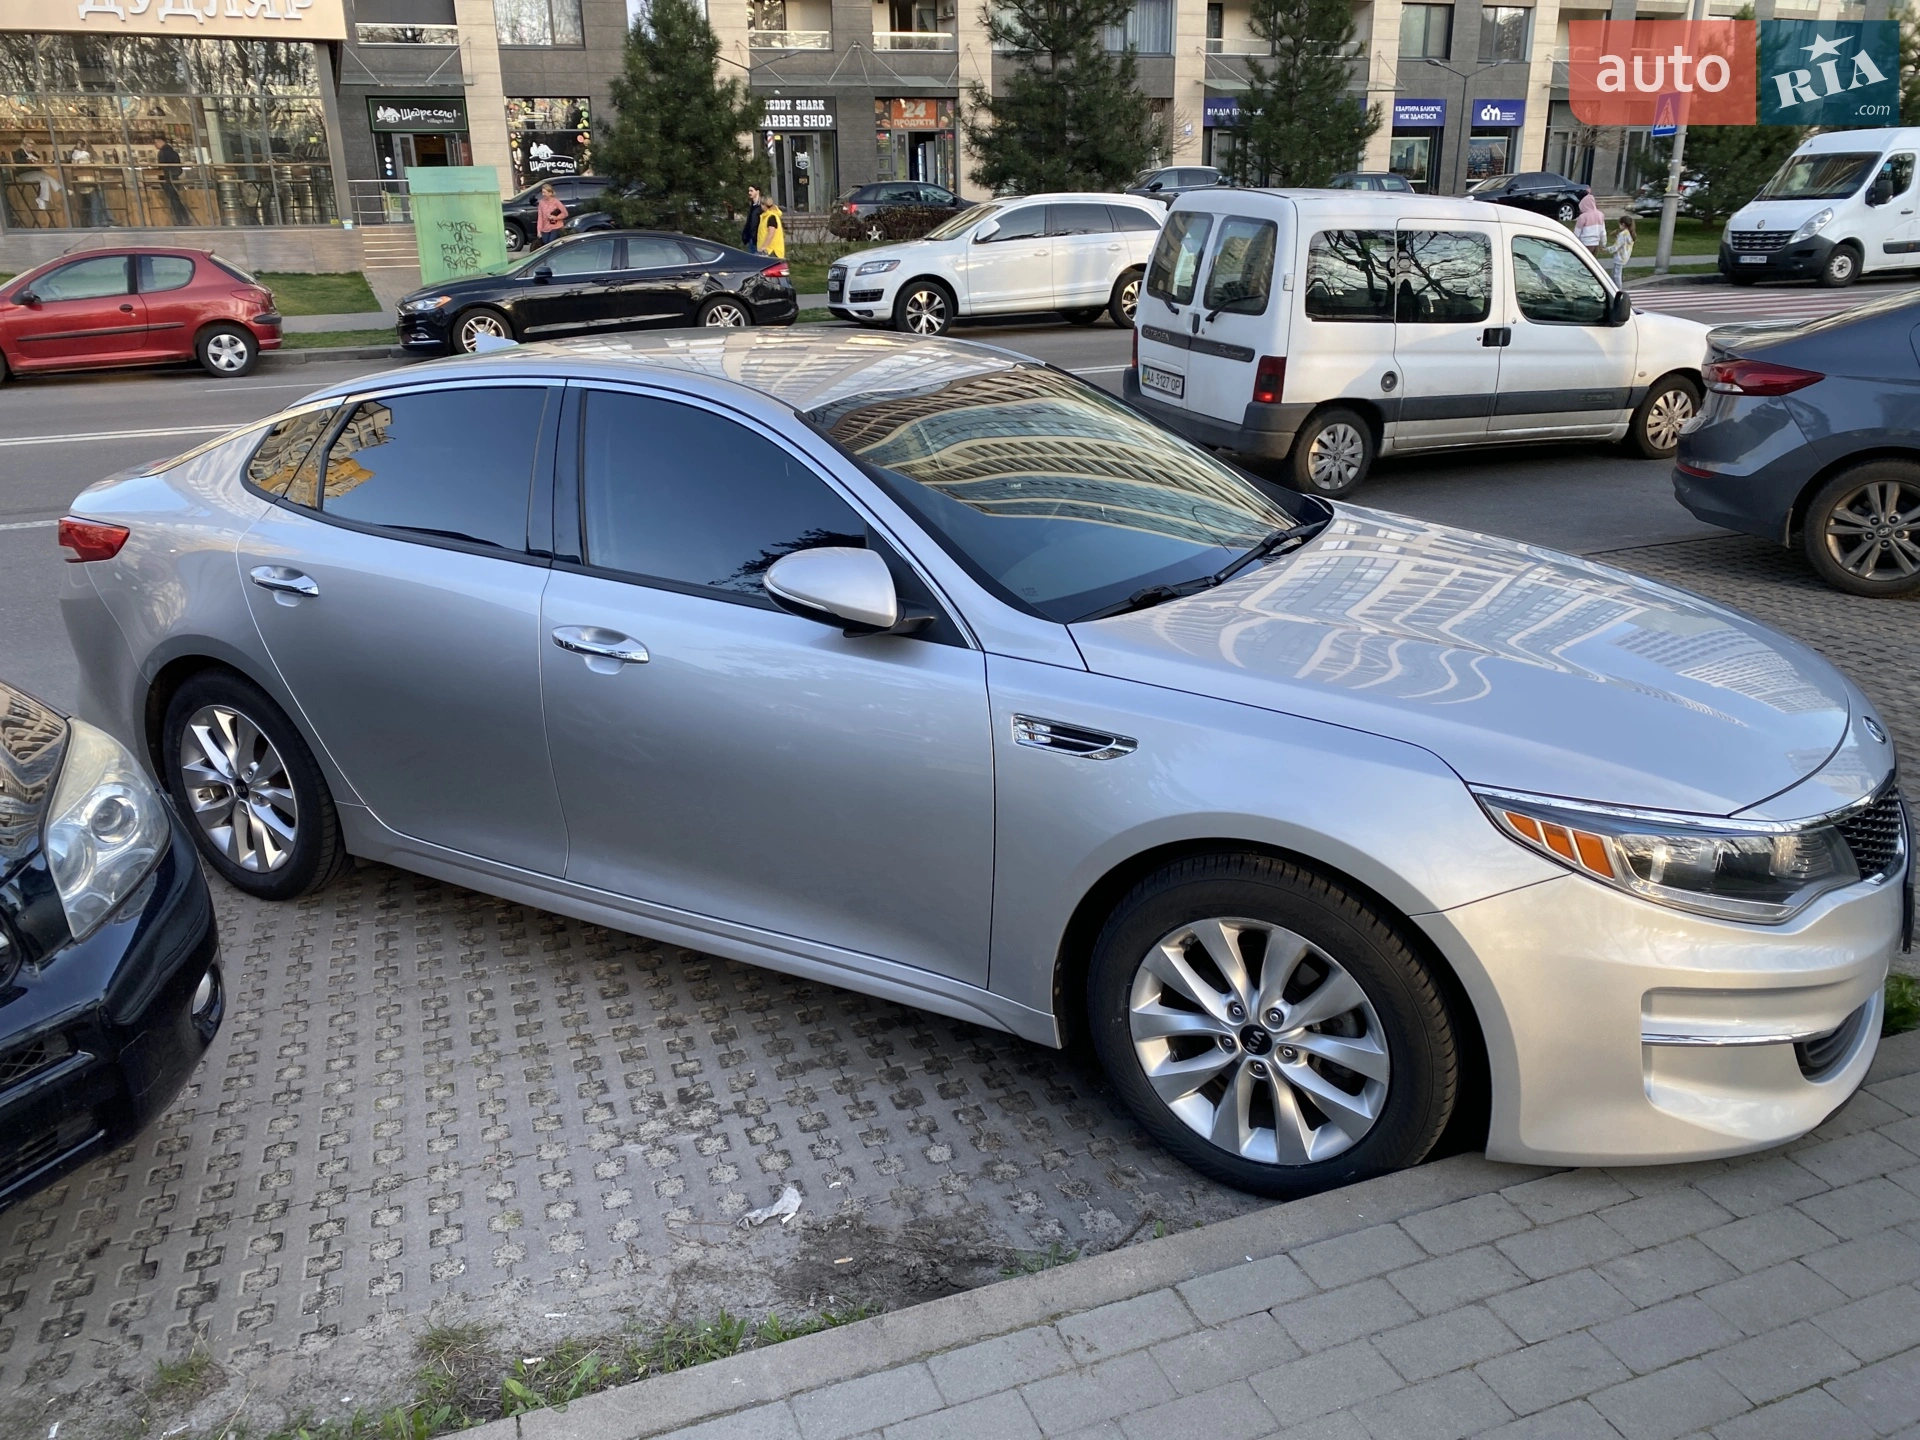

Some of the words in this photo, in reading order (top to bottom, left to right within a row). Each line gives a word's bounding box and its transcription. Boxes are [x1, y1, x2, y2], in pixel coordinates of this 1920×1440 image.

[795, 99, 825, 111] SHARK
[902, 101, 927, 118] 24
[400, 107, 432, 121] Щедре
[803, 114, 833, 127] SHOP
[893, 118, 935, 127] ПРОДУКТИ
[529, 160, 556, 172] Щедре
[1146, 370, 1154, 383] AA
[1156, 373, 1170, 389] 5127
[1246, 1030, 1265, 1053] KIA
